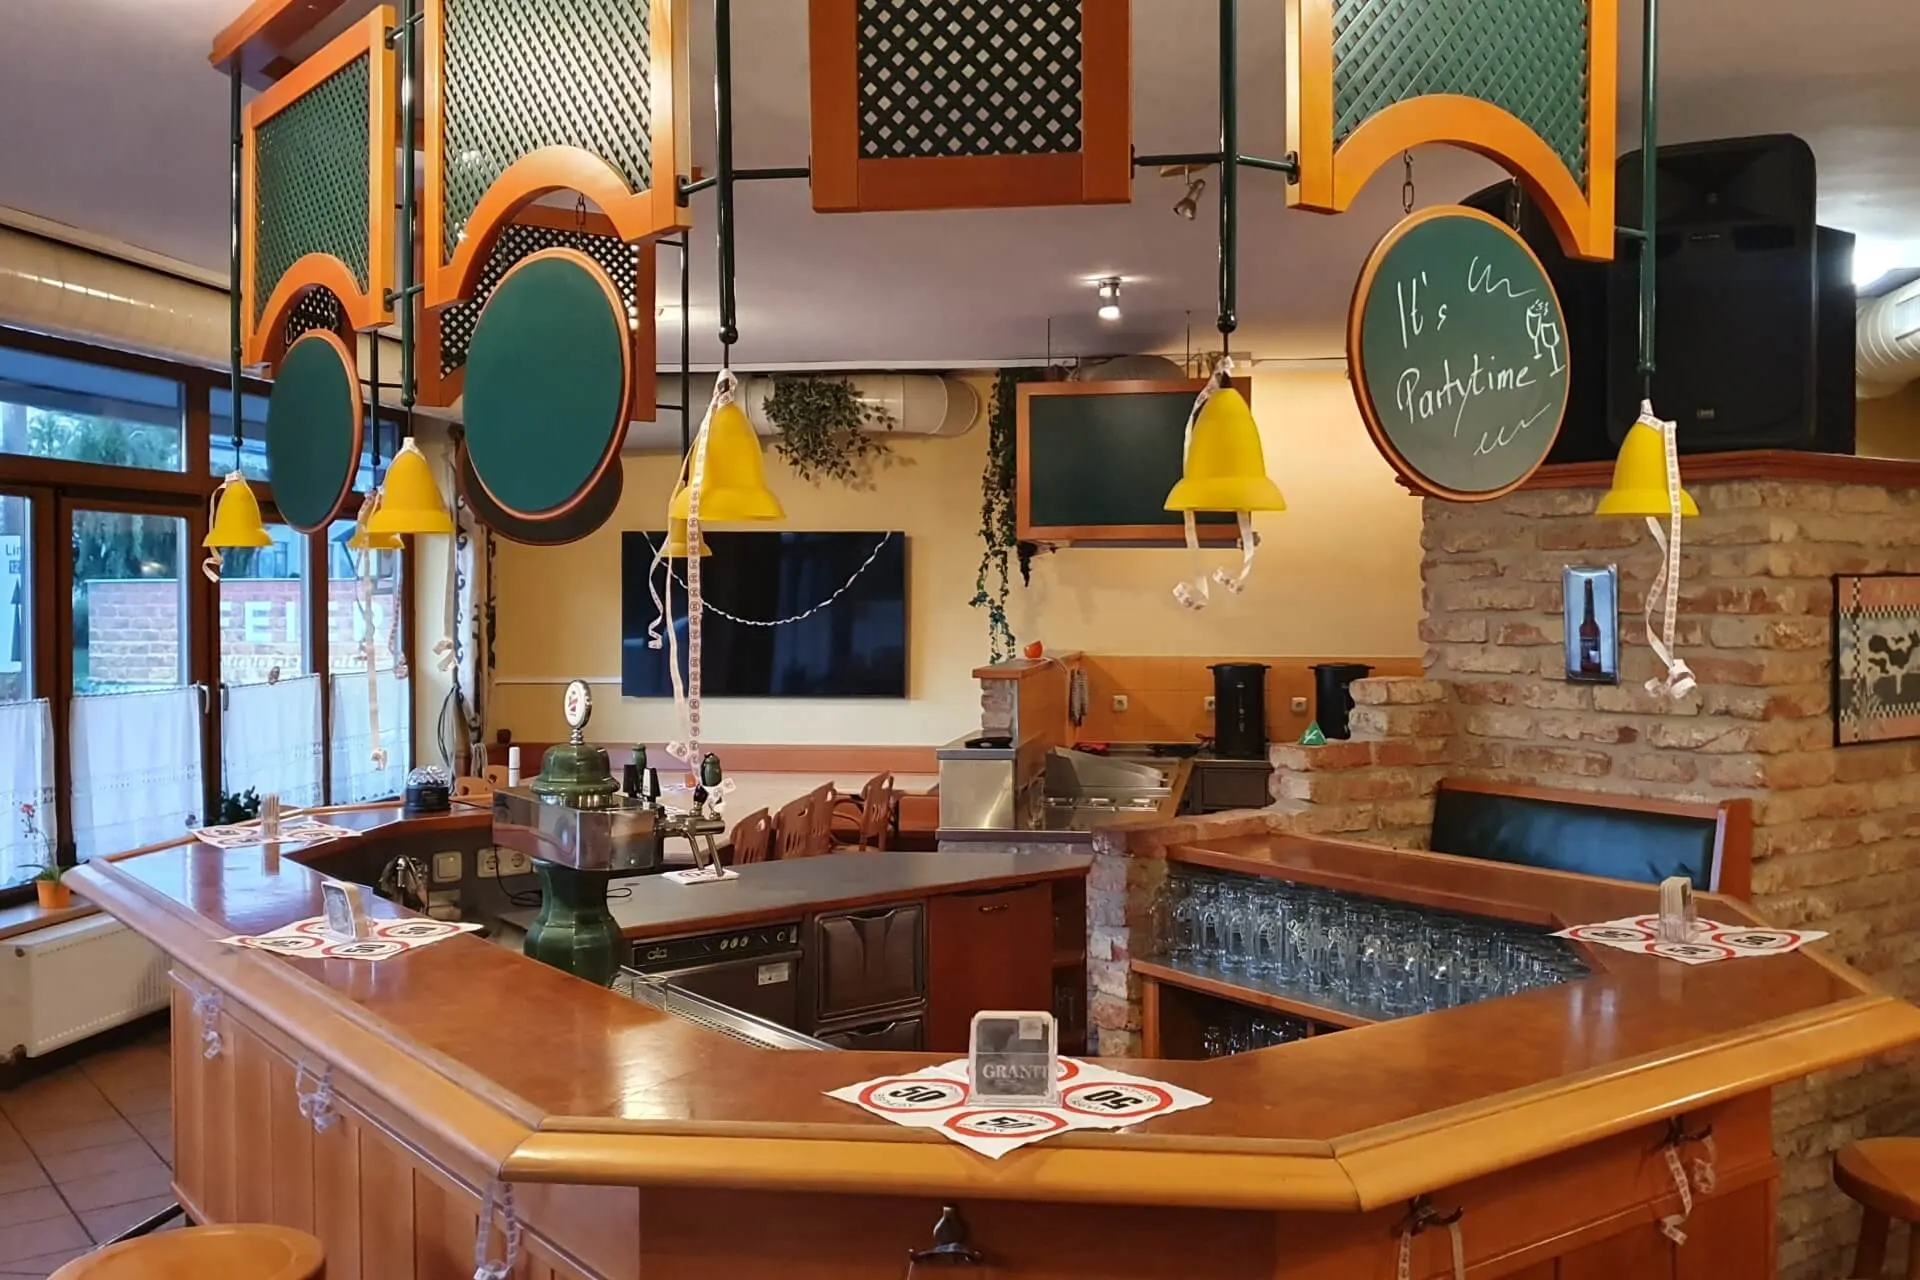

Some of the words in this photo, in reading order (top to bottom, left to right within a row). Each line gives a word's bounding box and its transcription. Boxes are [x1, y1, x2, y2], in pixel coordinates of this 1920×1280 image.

[1397, 271, 1448, 350] It's
[1397, 353, 1537, 437] Partytime
[888, 1086, 946, 1103] 50
[1083, 1089, 1143, 1110] 50
[975, 1116, 1036, 1129] 50
